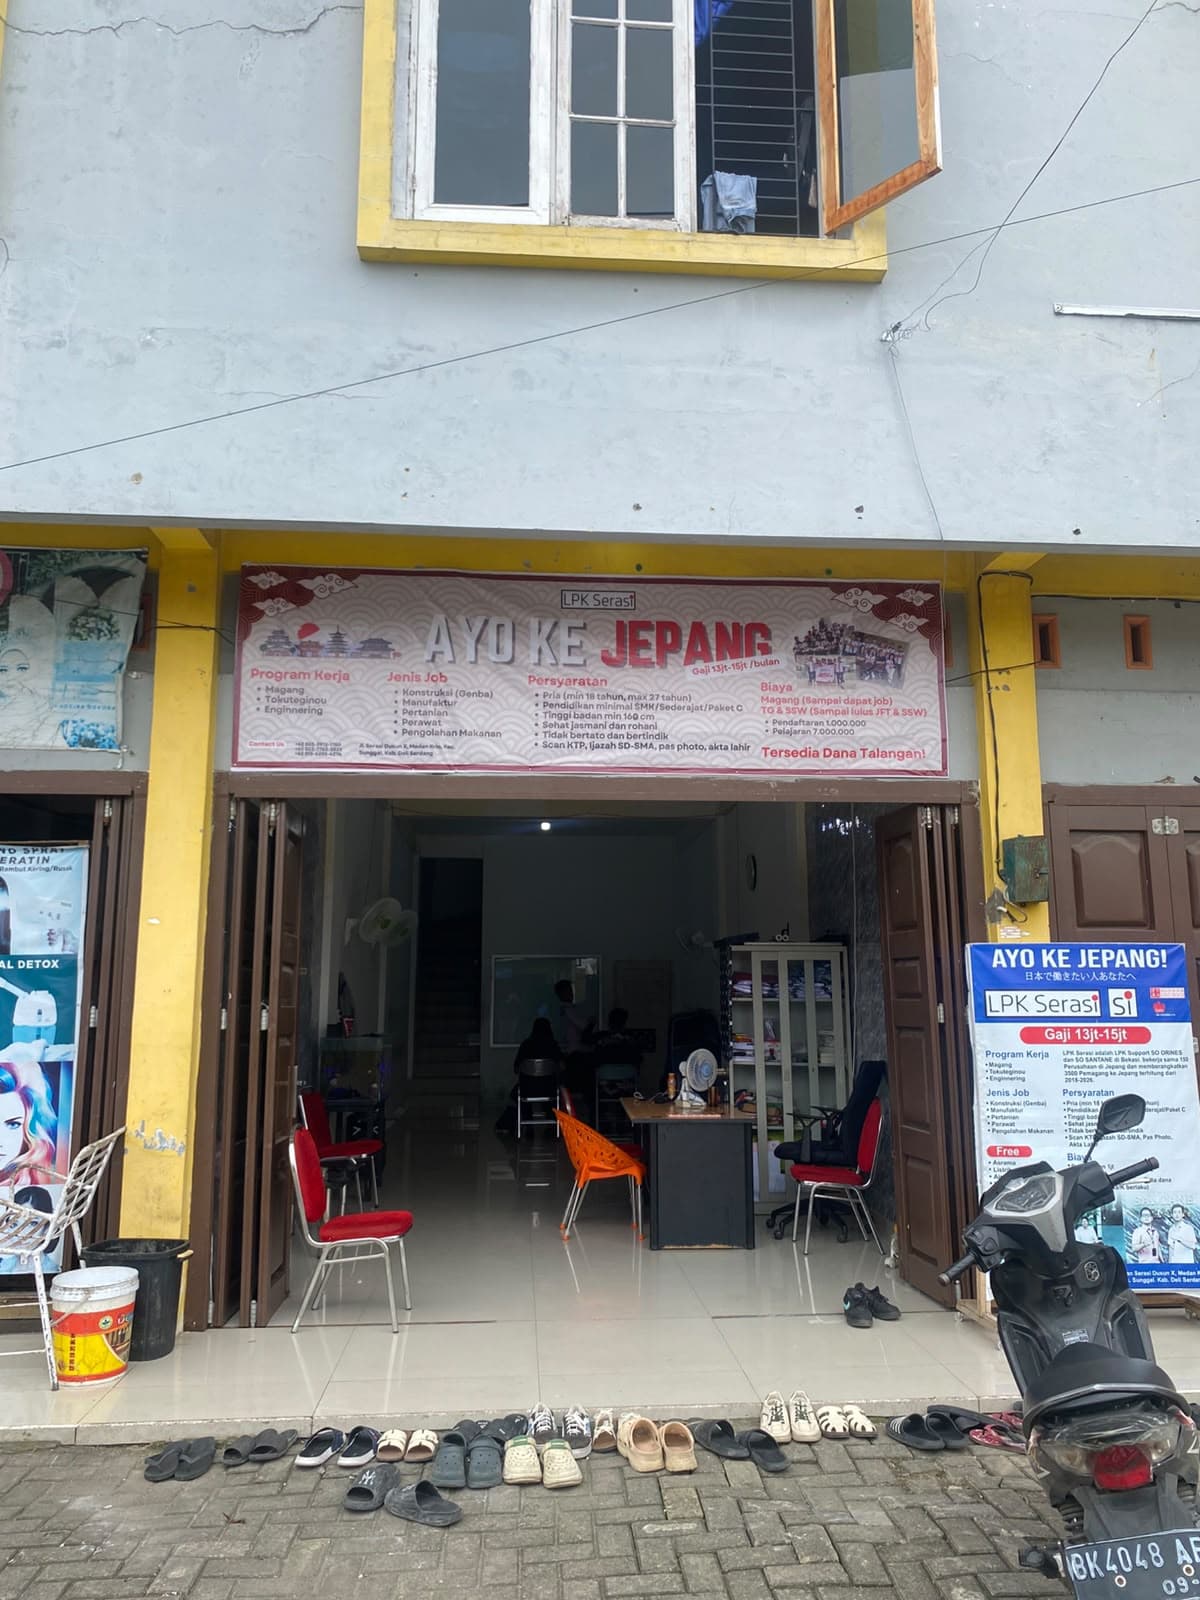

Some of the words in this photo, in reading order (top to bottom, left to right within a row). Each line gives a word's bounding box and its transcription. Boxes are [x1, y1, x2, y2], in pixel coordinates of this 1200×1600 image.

[563, 592, 590, 607] LPK
[593, 593, 635, 608] Serasi
[425, 614, 516, 665] AYO
[527, 615, 587, 667] KE
[600, 620, 773, 669] JEPANG
[250, 668, 311, 681] Program
[314, 670, 350, 683] Kerja
[692, 666, 711, 676] Gaji
[387, 671, 421, 682] Jenis
[424, 672, 448, 683] Job
[528, 674, 608, 688] Persyaratan
[265, 686, 305, 695] Magang
[760, 682, 793, 693] Biaya
[402, 688, 453, 697] Konstruksi
[455, 689, 494, 699] (Genba)
[543, 692, 560, 700] Pria
[563, 692, 584, 700] (min
[586, 692, 595, 700] 18
[597, 692, 626, 702] tahun,
[661, 694, 692, 702] tahun)
[265, 696, 327, 705] Tokuteginou
[761, 696, 800, 706] Magang
[802, 696, 841, 706] (Sampai
[843, 697, 872, 706] dapat
[874, 697, 893, 707] job)
[402, 708, 448, 716] Pertanian
[543, 701, 595, 710] Pendidikan
[596, 702, 633, 710] minimal
[736, 704, 743, 712] C
[543, 712, 571, 720] Tinggi
[573, 712, 602, 720] badan
[604, 712, 621, 720] min
[624, 712, 639, 720] 160
[785, 707, 807, 715] SSW
[810, 707, 849, 717] (Sampai
[851, 708, 873, 716] lulus
[876, 708, 891, 716] JFT
[893, 708, 900, 716] &
[902, 708, 928, 718] SSW)
[542, 721, 569, 729] Sehat
[571, 721, 606, 730] jasmani
[608, 722, 626, 730] dan
[628, 722, 658, 730] rohani
[772, 719, 825, 727] Pendaftaran
[402, 729, 457, 738] Pengolahan
[459, 729, 502, 738] Makanan
[607, 732, 624, 740] dan
[626, 732, 668, 740] bertindik
[772, 728, 812, 736] Pelajaran
[814, 728, 855, 736] 7.000.000
[542, 741, 565, 749] Scan
[567, 741, 588, 750] KTP,
[589, 742, 616, 750] Ijazah
[618, 742, 656, 750] SD-SMA,
[659, 744, 676, 752] pas
[677, 743, 706, 752] photo,
[730, 744, 751, 752] lahir
[762, 747, 820, 758] Tersedia
[822, 748, 857, 759] Dana
[860, 748, 926, 762] Talangan!
[992, 948, 1036, 968] AYO
[1042, 948, 1070, 968] KE
[1078, 948, 1168, 968] JEPANG!
[18, 959, 60, 969] DETOX
[987, 994, 1030, 1014] LPK
[1034, 994, 1099, 1014] Serasi
[1112, 991, 1133, 1016] Si
[1044, 1028, 1072, 1043] Gaji
[1075, 1027, 1128, 1043] 13jt-15jt
[985, 1050, 1024, 1060] Program
[1026, 1050, 1050, 1060] Kerja
[986, 1088, 1010, 1096] Jenis
[1012, 1088, 1030, 1096] Job
[1062, 1088, 1114, 1098] Persyaratan
[996, 1146, 1020, 1156] Free
[1070, 1550, 1104, 1580] BK
[1106, 1542, 1164, 1574] 4048
